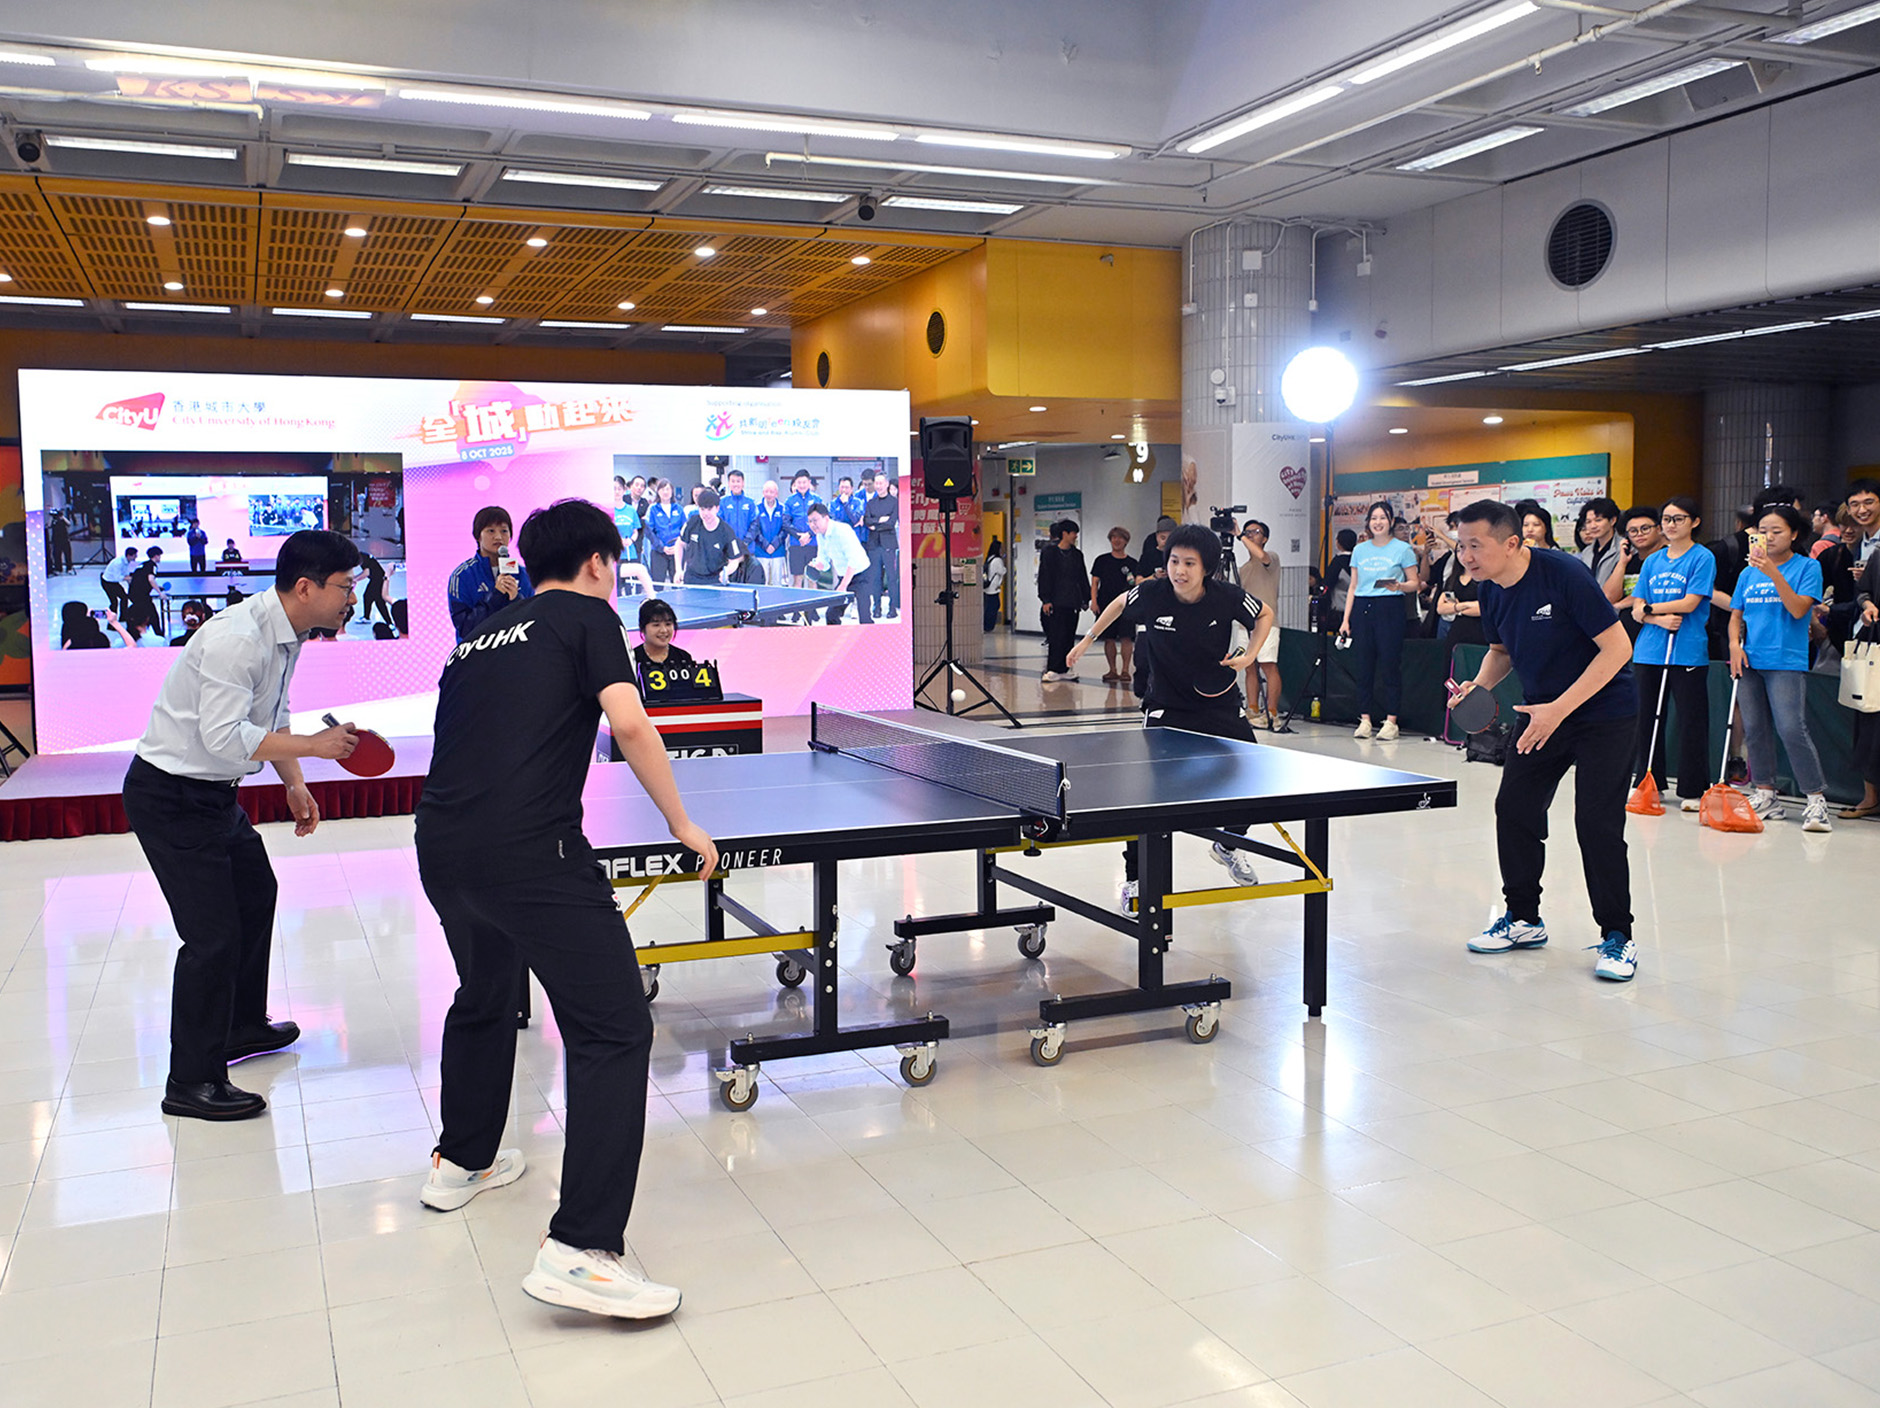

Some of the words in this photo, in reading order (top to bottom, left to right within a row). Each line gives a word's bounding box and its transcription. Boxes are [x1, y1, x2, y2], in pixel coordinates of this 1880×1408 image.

[102, 405, 159, 425] CityU
[469, 449, 487, 459] OCT
[649, 670, 667, 690] 3
[695, 668, 712, 687] 4
[695, 848, 782, 872] PONEER
